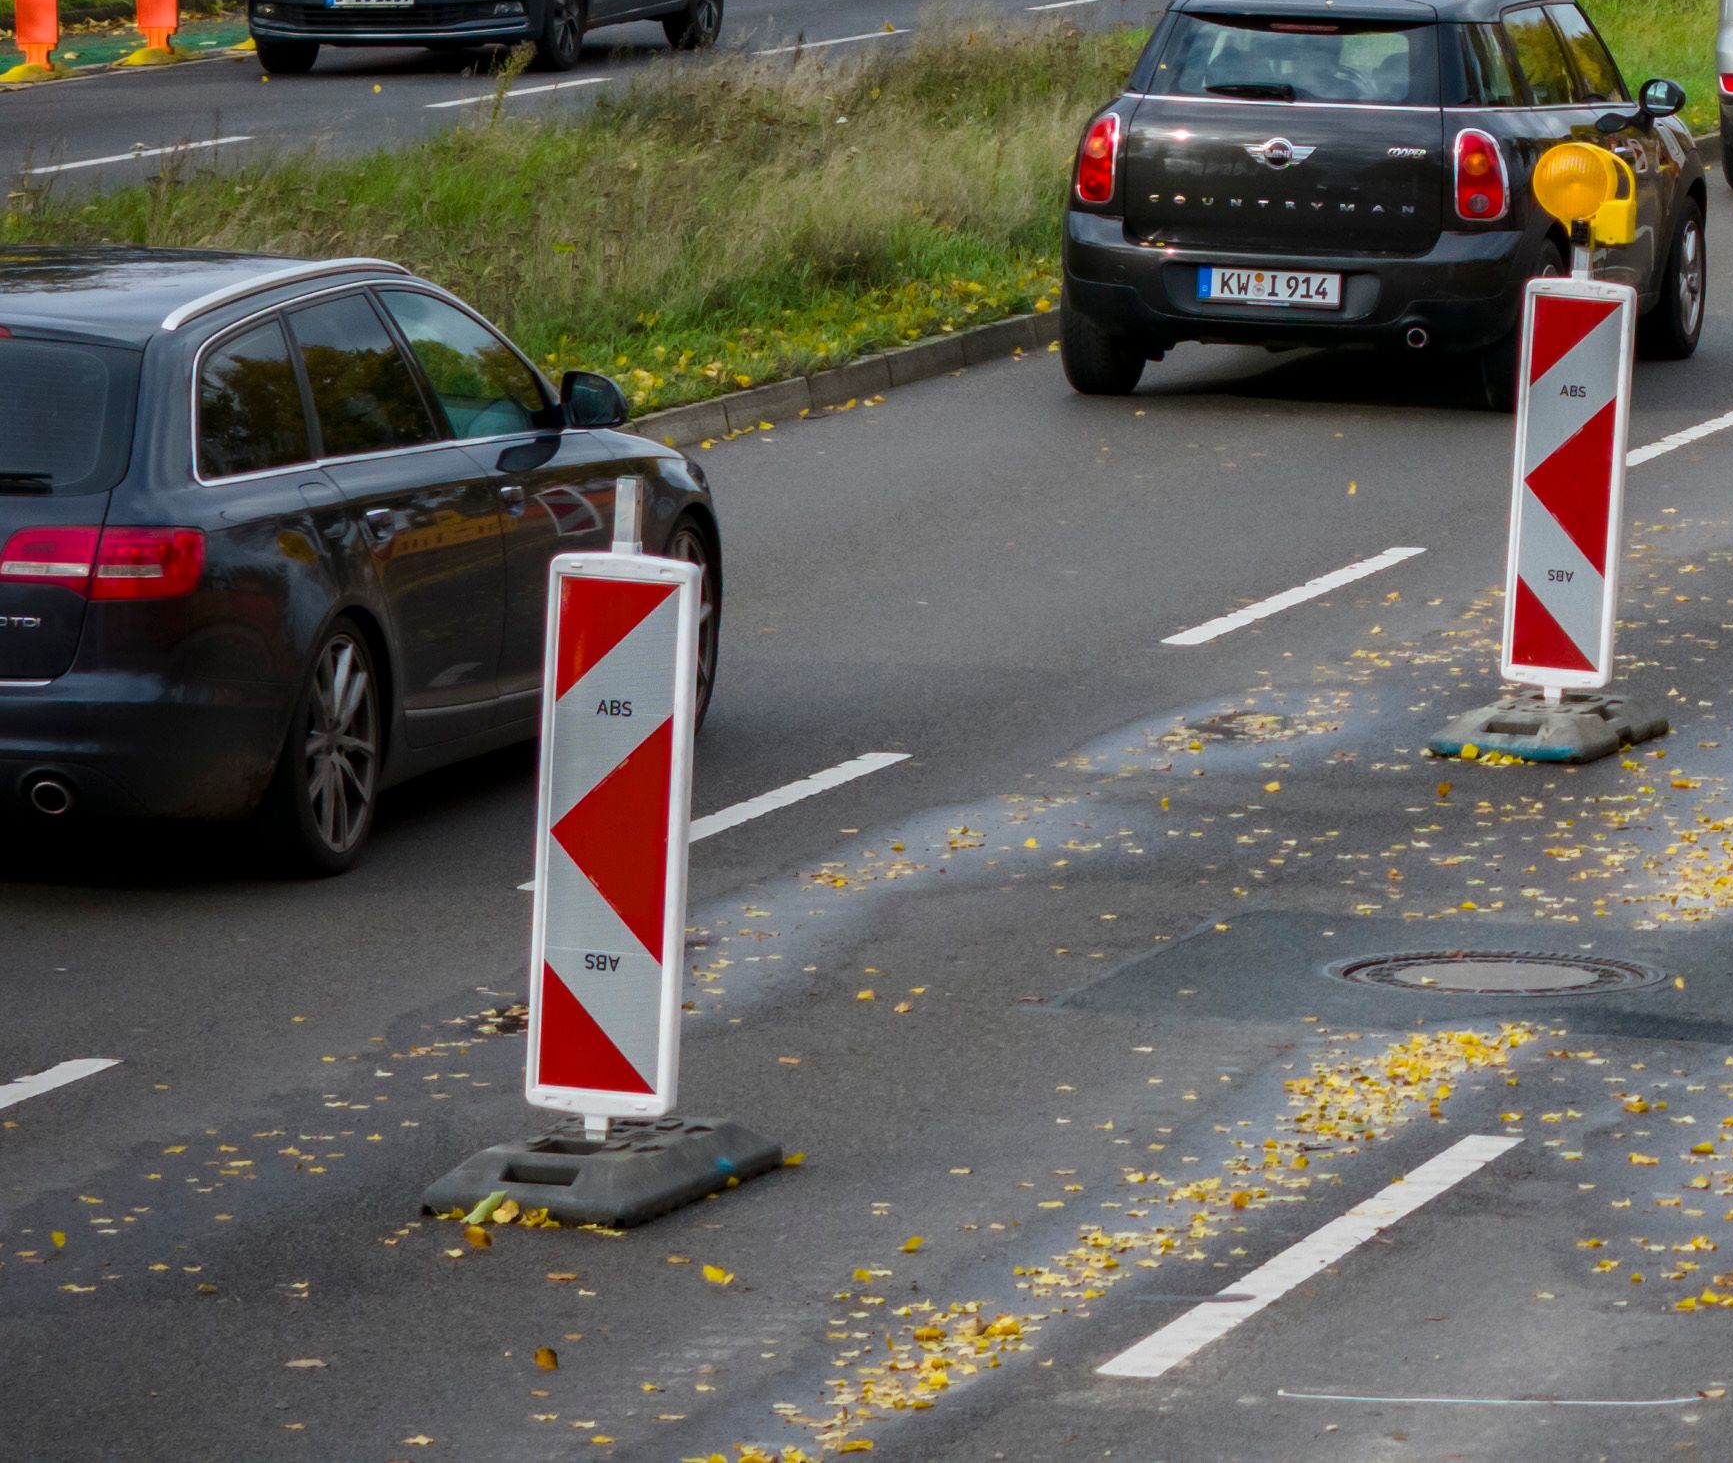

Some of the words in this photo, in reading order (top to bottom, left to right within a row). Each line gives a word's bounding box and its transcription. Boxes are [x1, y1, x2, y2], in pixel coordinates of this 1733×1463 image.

[1266, 148, 1291, 160] MINI
[1149, 193, 1415, 215] COUNTRYMAN
[1220, 271, 1251, 297] KW
[1267, 274, 1279, 298] I
[1286, 276, 1329, 300] 914
[1559, 384, 1587, 398] ABS
[1547, 569, 1575, 583] ABS
[10, 616, 42, 628] TDI
[596, 699, 633, 718] ABS
[584, 953, 621, 973] ABS
